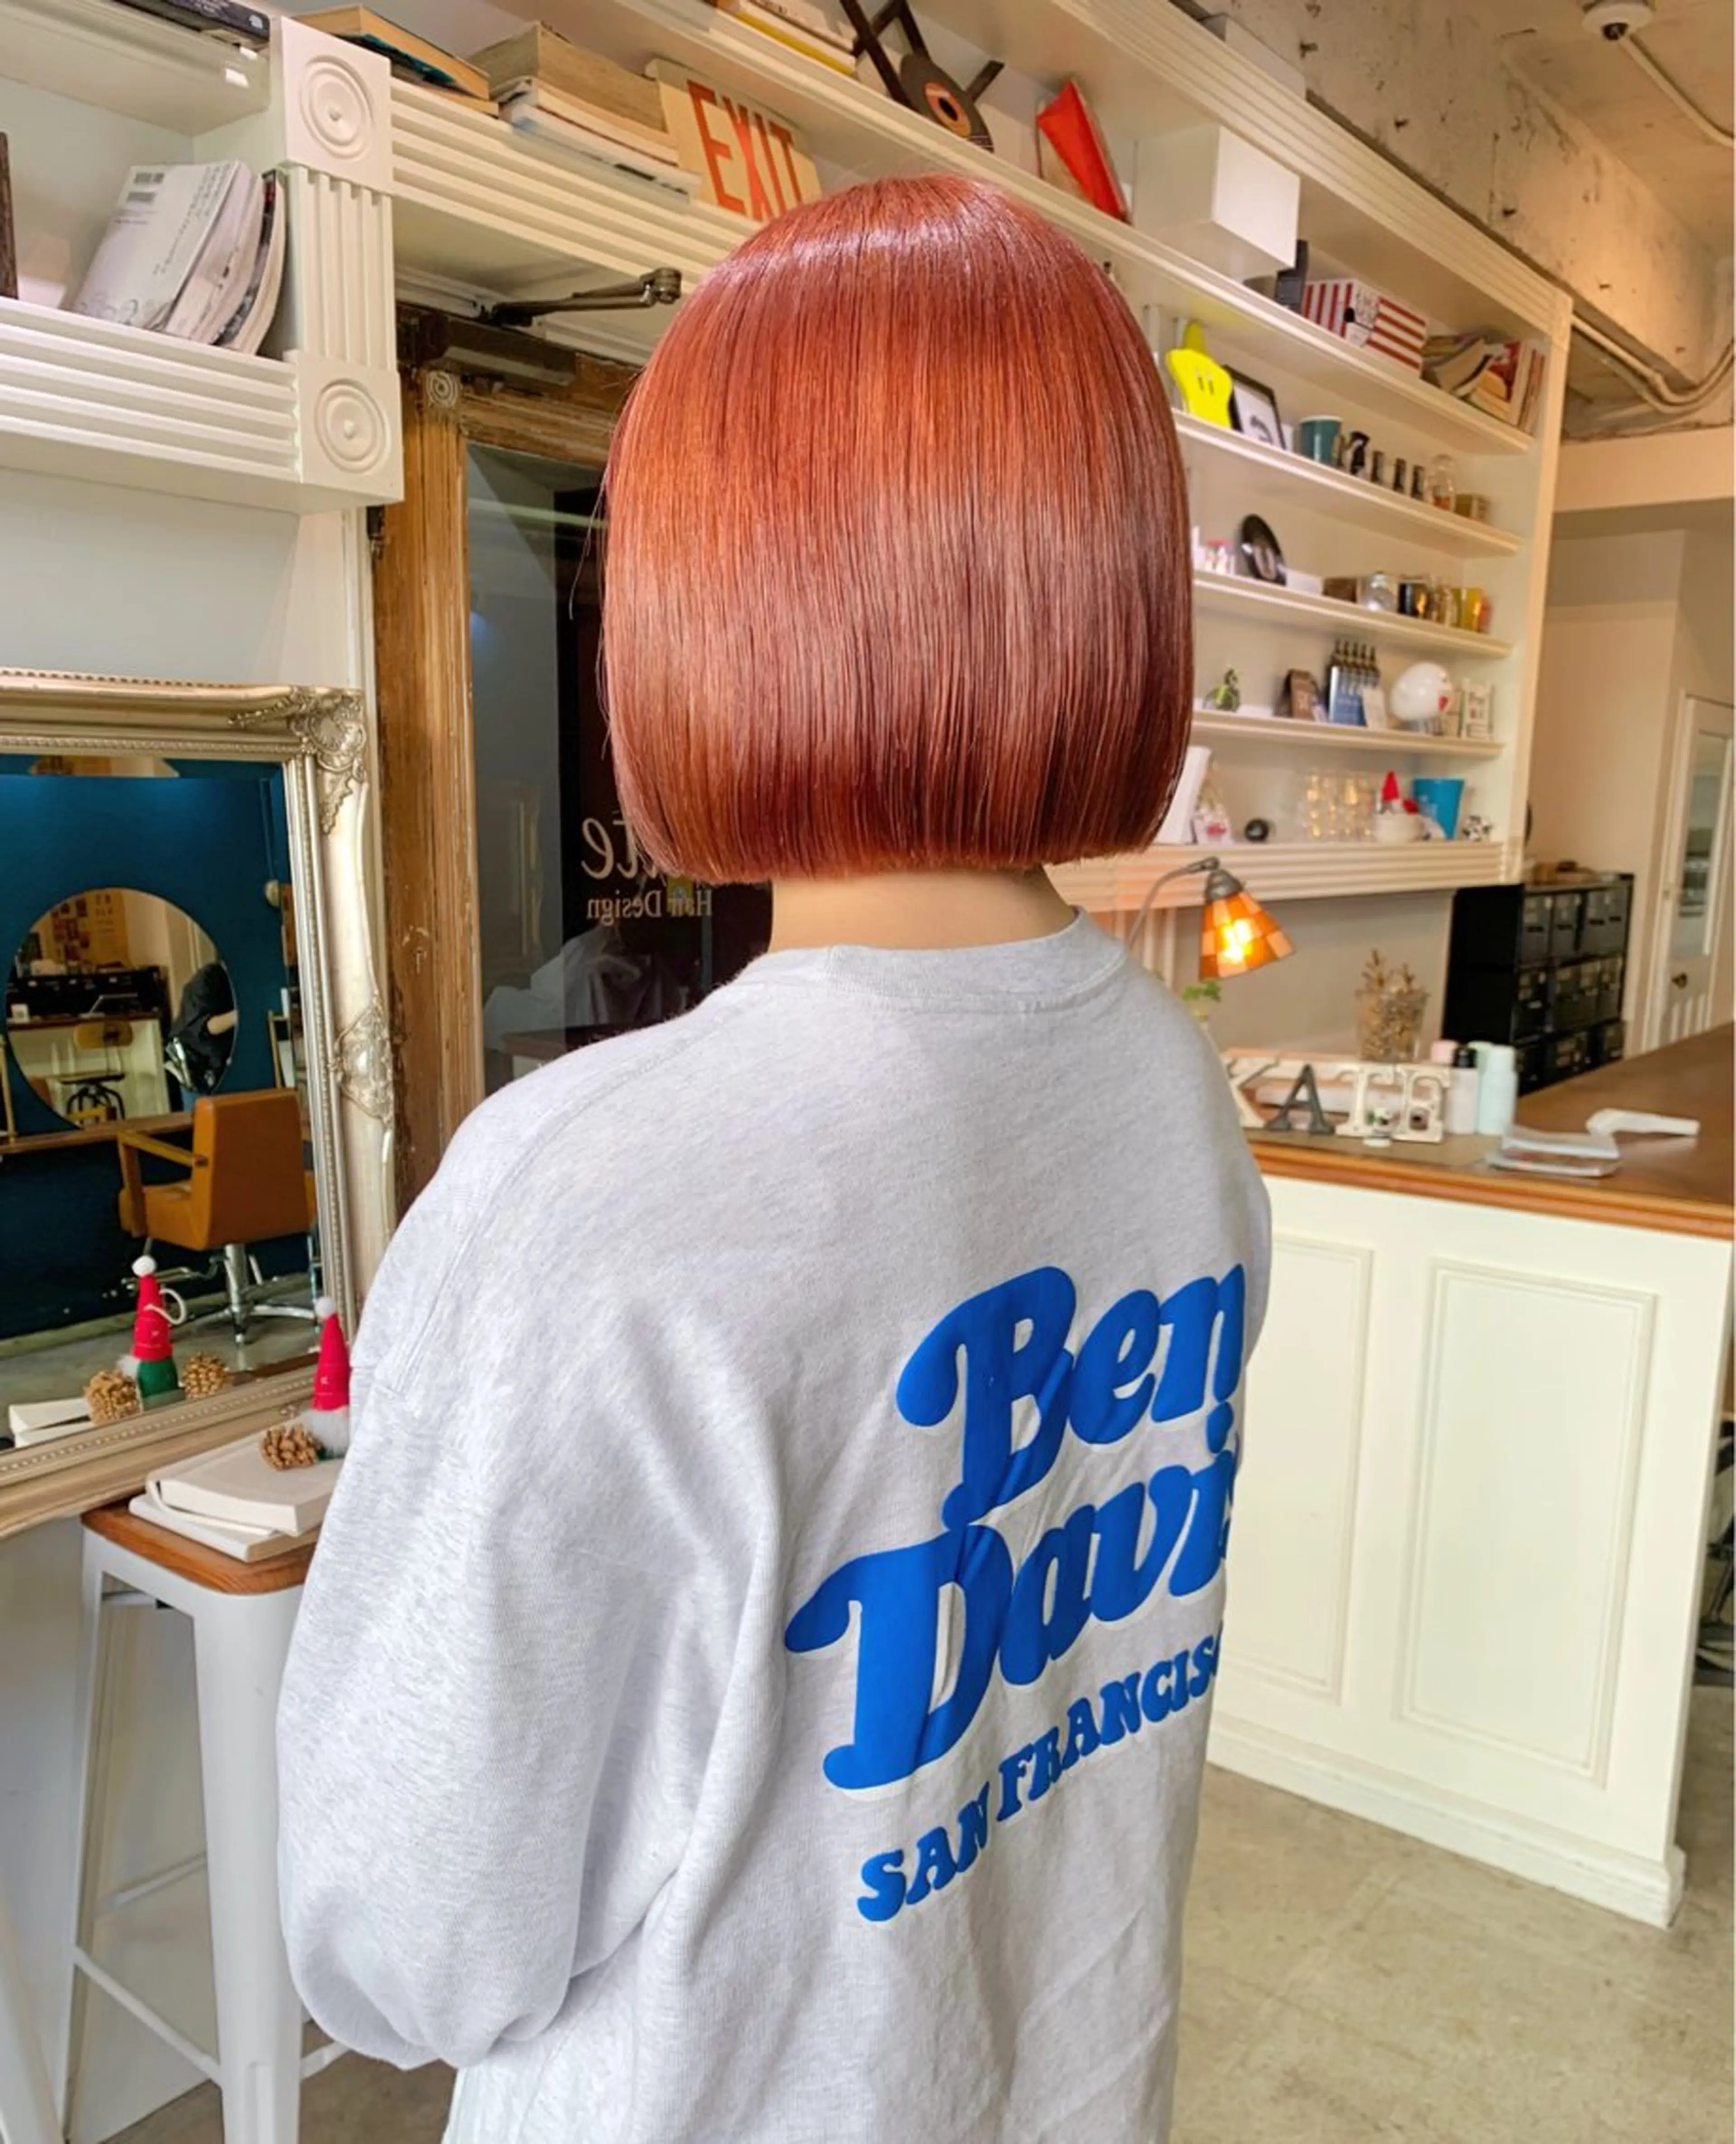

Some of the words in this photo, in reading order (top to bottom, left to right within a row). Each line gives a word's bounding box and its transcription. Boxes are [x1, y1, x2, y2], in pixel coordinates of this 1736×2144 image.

[686, 79, 802, 221] EXIT
[896, 1263, 1246, 1531] Ben
[784, 1401, 1239, 1789] Davi
[857, 1781, 990, 1922] SAN
[995, 1619, 1222, 1822] FRANCIS
